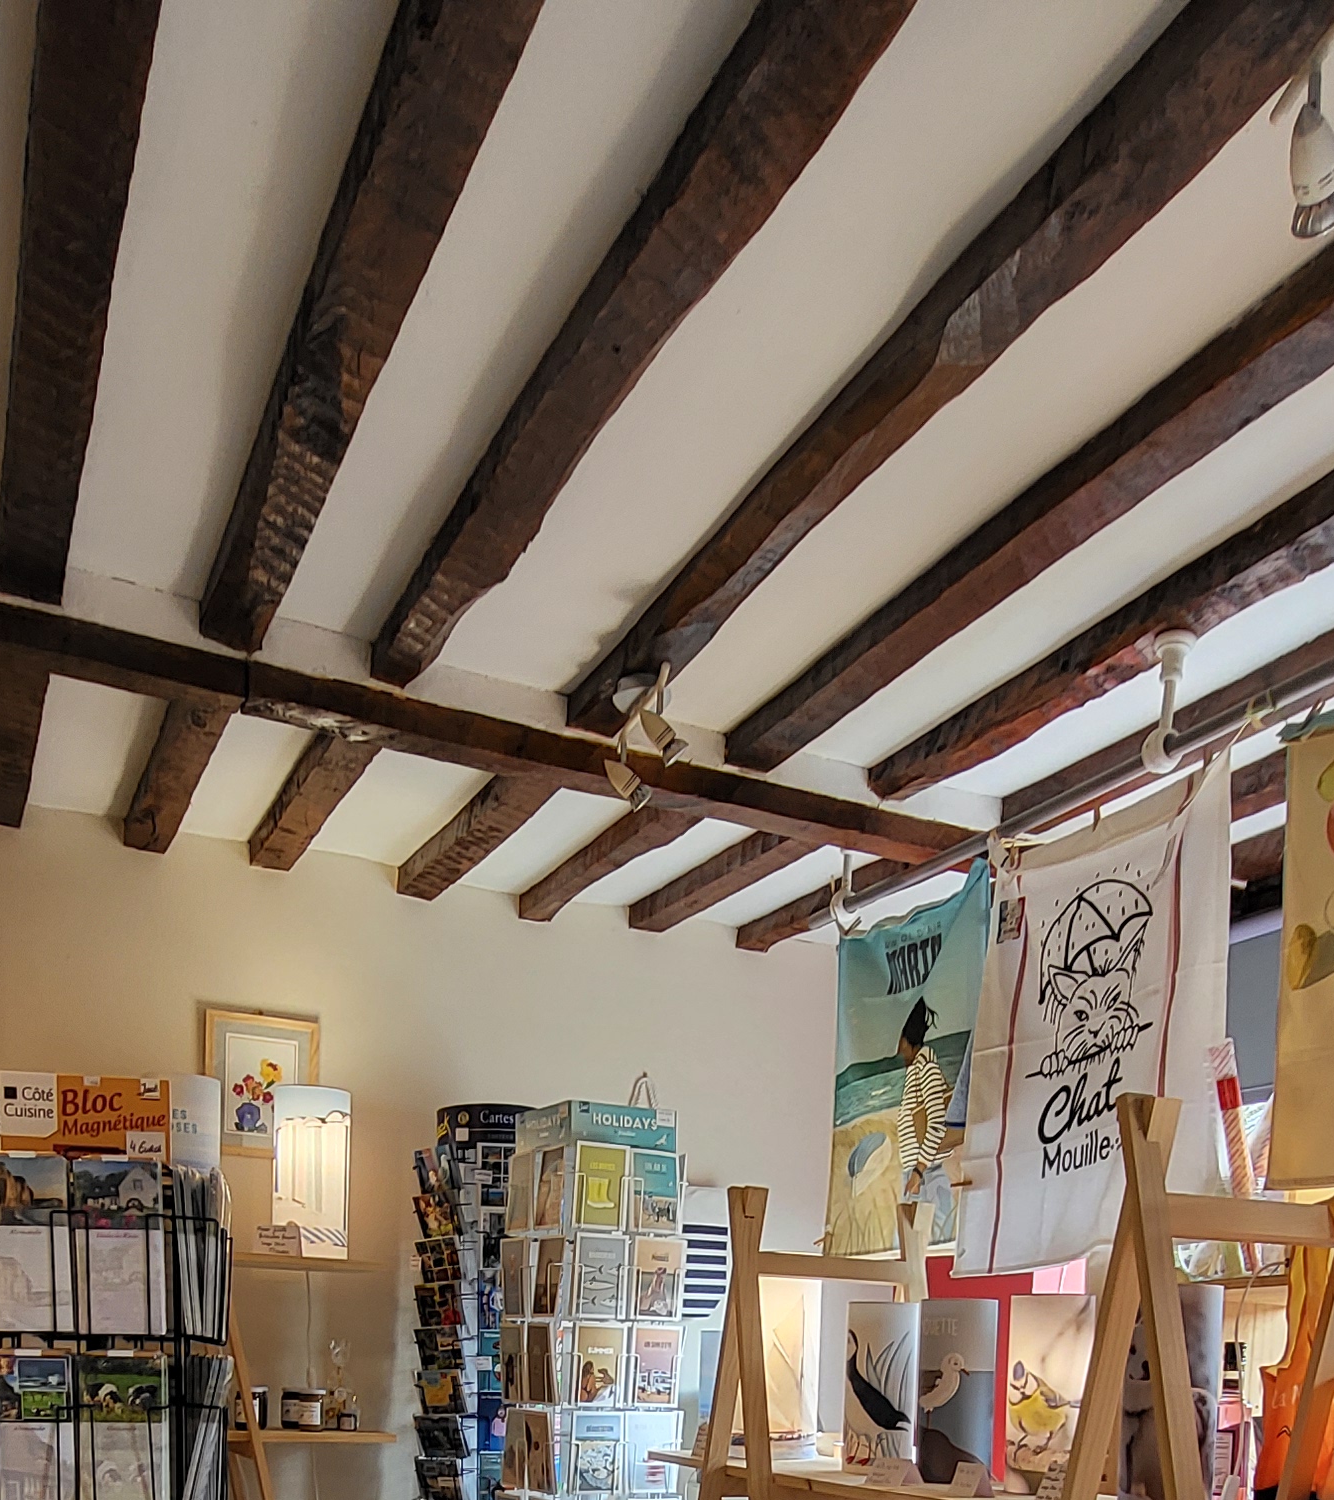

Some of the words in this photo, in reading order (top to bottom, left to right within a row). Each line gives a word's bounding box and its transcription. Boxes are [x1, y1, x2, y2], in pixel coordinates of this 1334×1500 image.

[21, 1086, 54, 1102] Côté
[61, 1088, 123, 1117] Bloc
[1038, 1056, 1124, 1145] Chat
[3, 1103, 54, 1119] Cuisine
[479, 1108, 515, 1126] Cartes
[592, 1111, 659, 1131] HOLIDAYS
[61, 1112, 167, 1138] Magnétique
[129, 1139, 136, 1151] 4
[1041, 1128, 1111, 1180] Mouille
